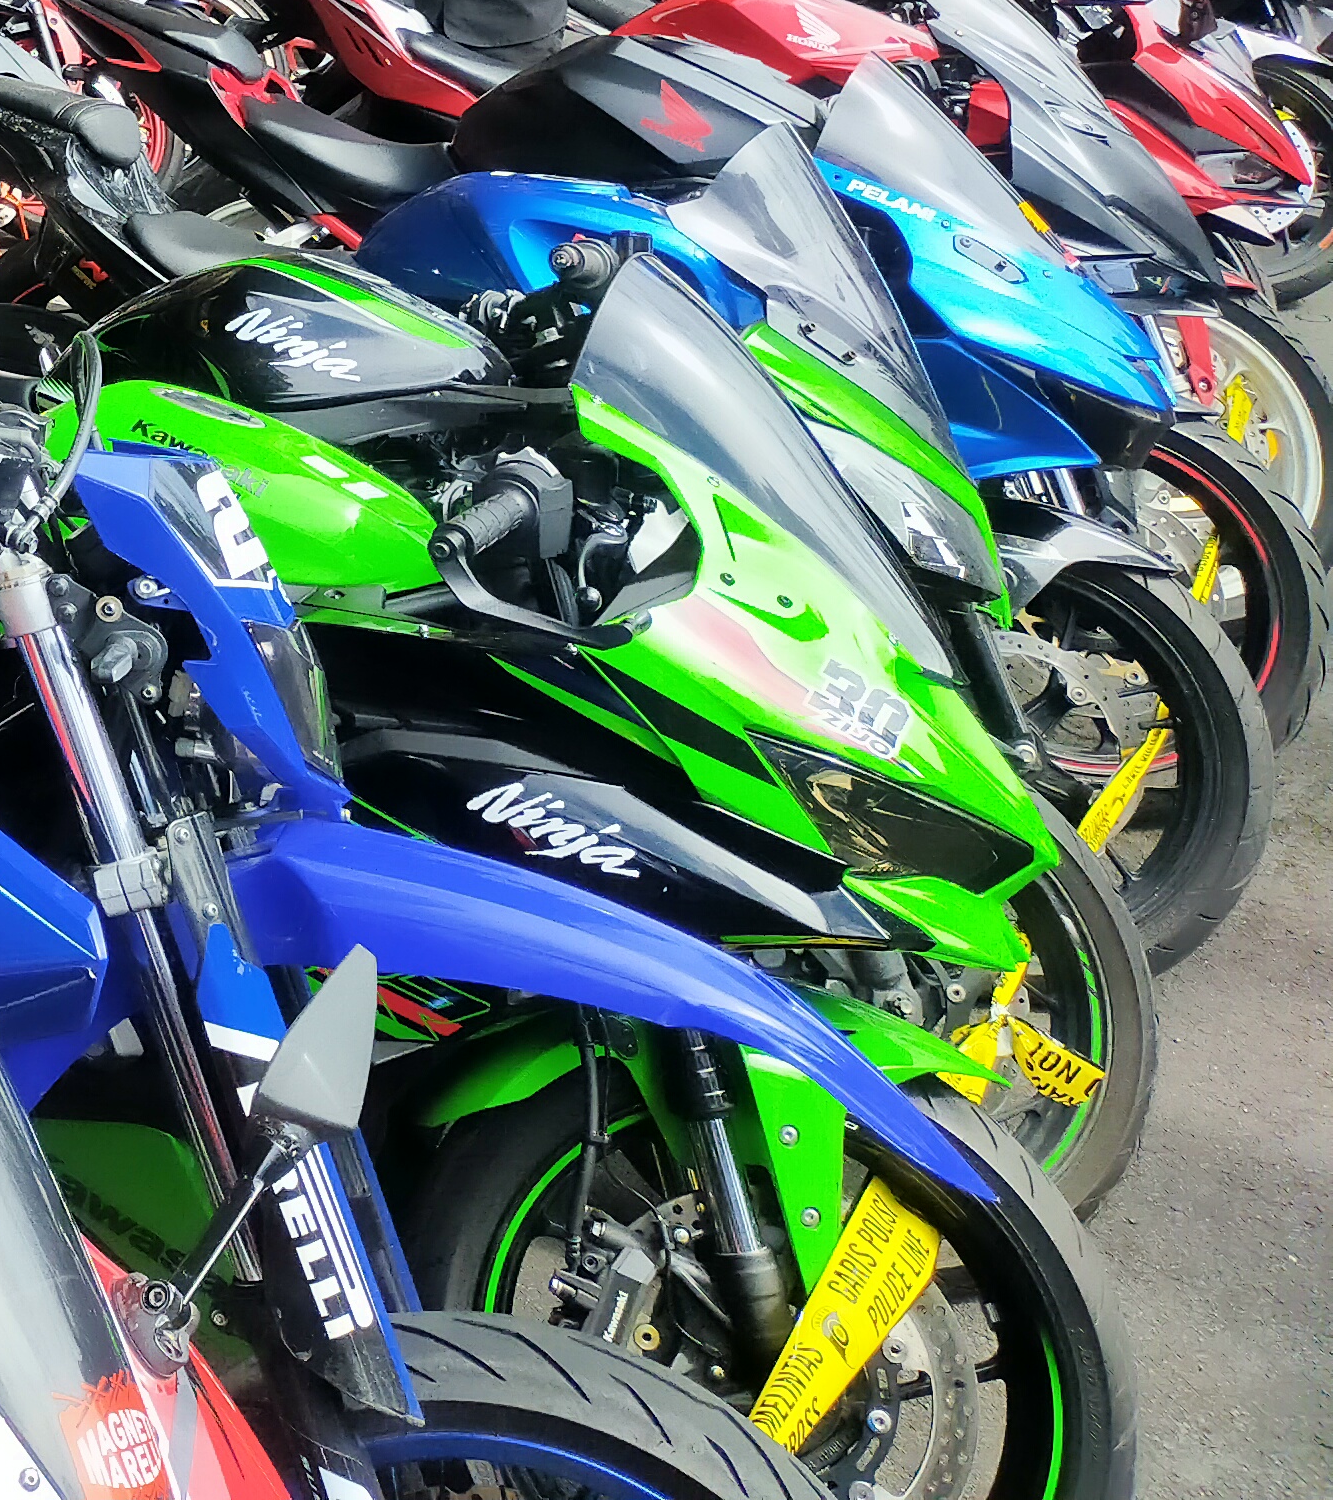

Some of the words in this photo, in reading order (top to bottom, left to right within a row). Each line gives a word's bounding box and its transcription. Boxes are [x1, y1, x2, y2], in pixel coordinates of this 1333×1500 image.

[786, 32, 839, 55] HONDA
[224, 307, 362, 383] Ninja
[808, 658, 911, 747] 30
[465, 782, 640, 880] Ninja
[826, 1242, 878, 1306] GARIS
[856, 1192, 900, 1256] POLISI
[866, 1261, 914, 1338] POLICE
[897, 1228, 930, 1278] LINE
